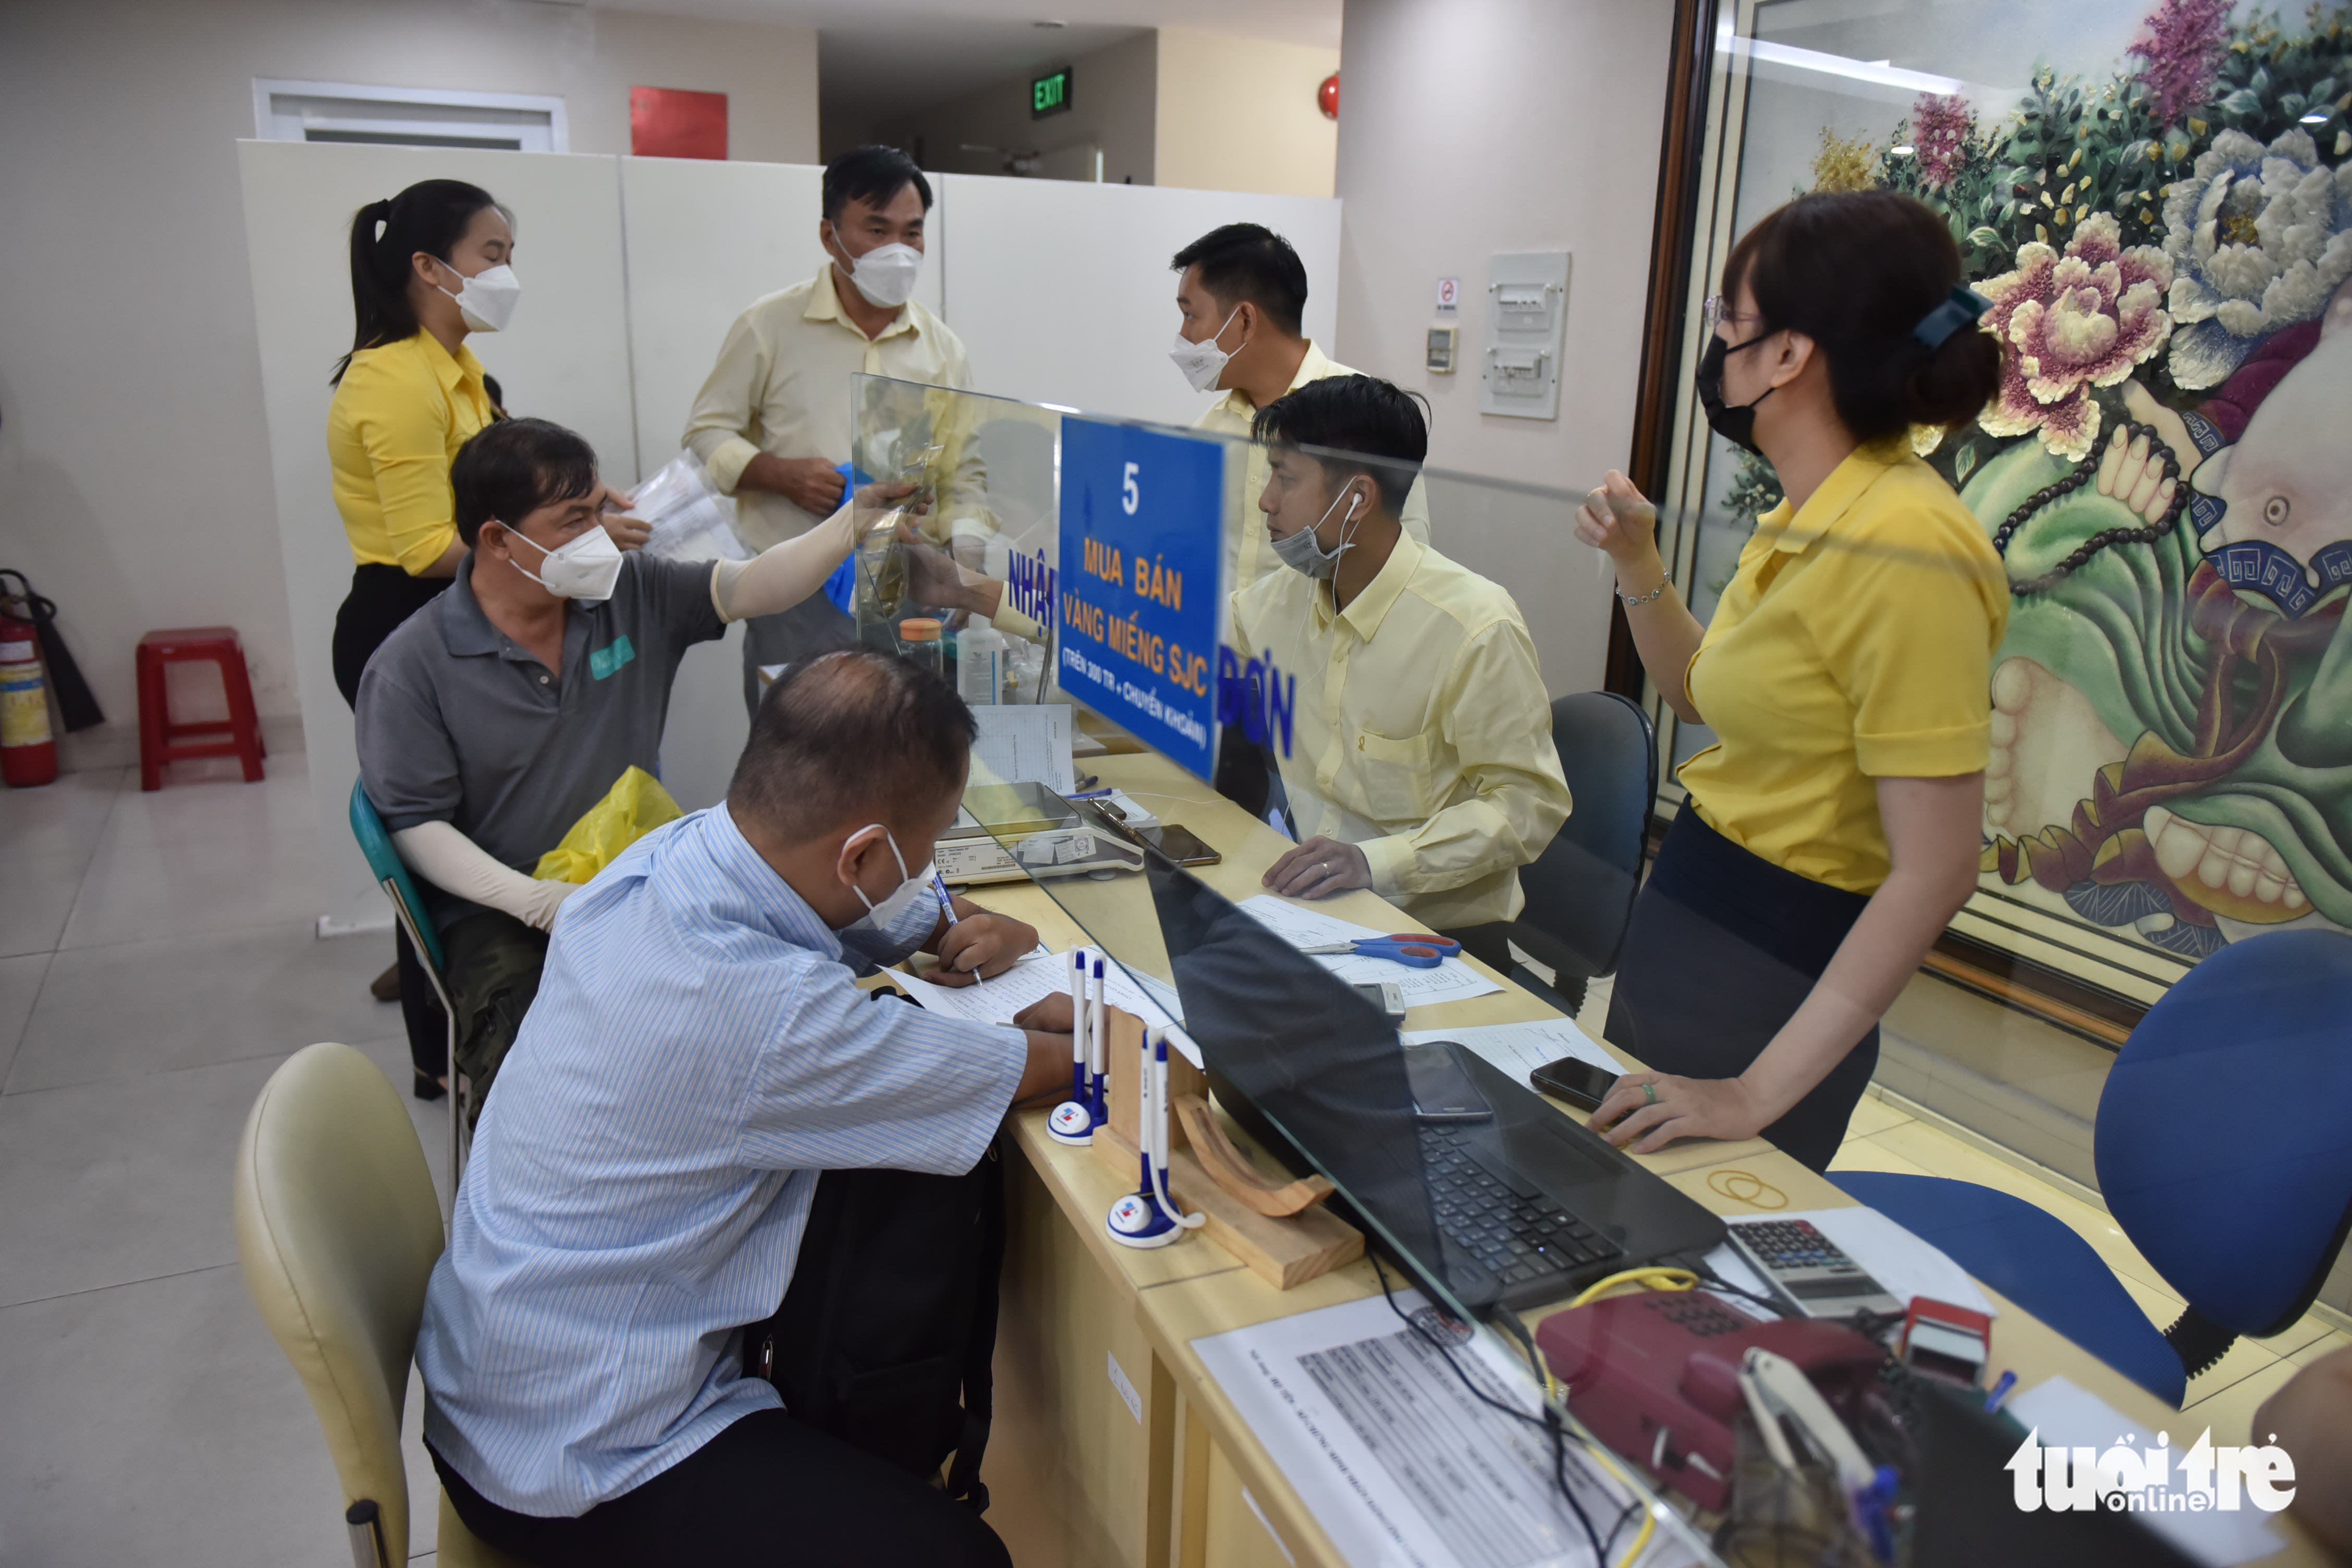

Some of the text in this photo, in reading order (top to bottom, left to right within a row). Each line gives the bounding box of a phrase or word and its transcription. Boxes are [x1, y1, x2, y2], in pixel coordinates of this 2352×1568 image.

[1034, 74, 1064, 110] EXIT
[1121, 461, 1140, 516] 5
[1084, 537, 1182, 612] MUA BÁN
[1062, 646, 1087, 676] (TRÊN
[1103, 668, 1116, 693] TR
[1063, 587, 1207, 698] VÀNG MIẾNG SJC
